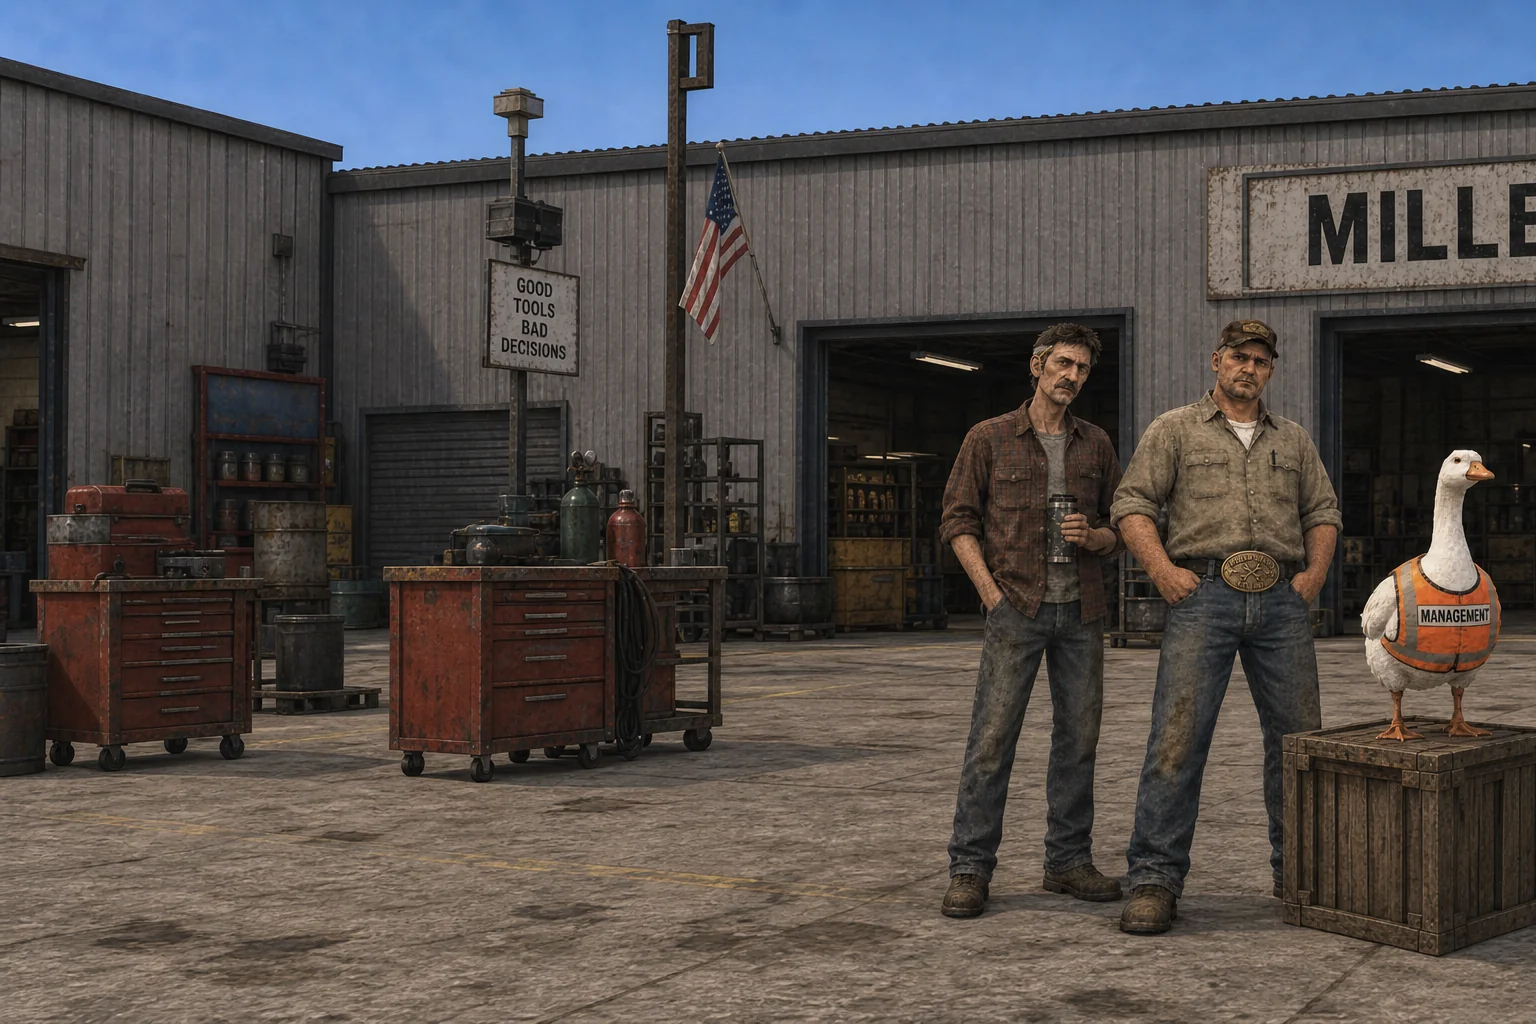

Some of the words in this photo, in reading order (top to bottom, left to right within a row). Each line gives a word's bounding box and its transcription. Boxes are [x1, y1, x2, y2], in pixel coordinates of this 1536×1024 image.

[516, 277, 553, 298] GOOD
[513, 297, 555, 319] TOOLS
[521, 319, 548, 338] BAD
[501, 337, 566, 360] DECISIONS
[1421, 608, 1489, 623] MANAGEMENT
